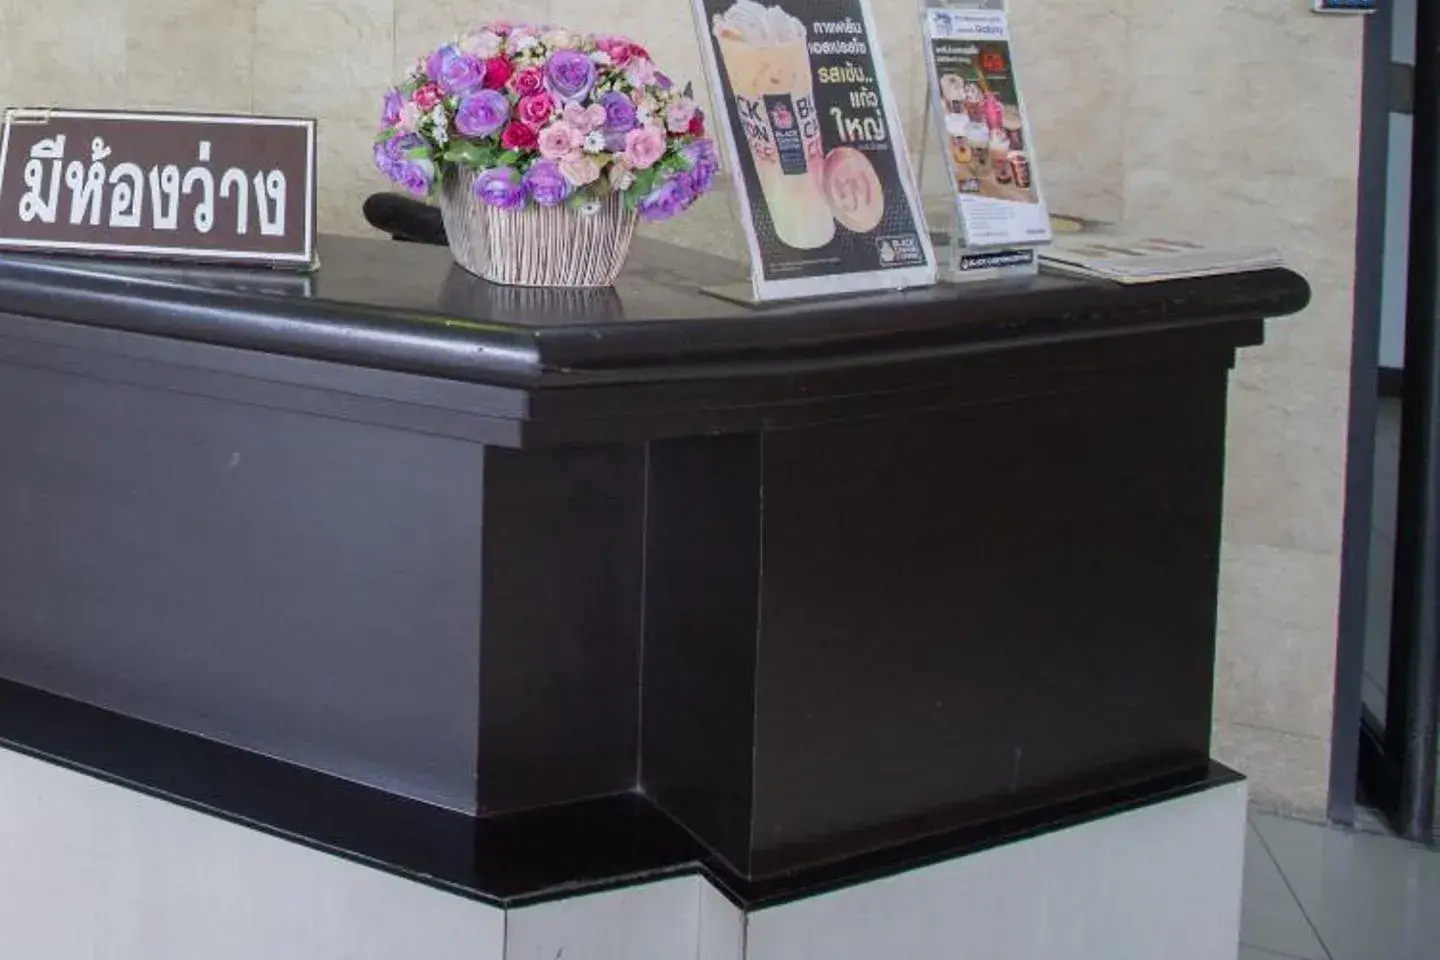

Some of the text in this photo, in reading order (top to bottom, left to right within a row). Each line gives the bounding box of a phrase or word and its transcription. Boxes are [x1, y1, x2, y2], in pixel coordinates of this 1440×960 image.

[850, 86, 878, 108] แก้ว
[828, 107, 885, 143] ใหญ่
[18, 134, 287, 236] มีห้องว่าง
